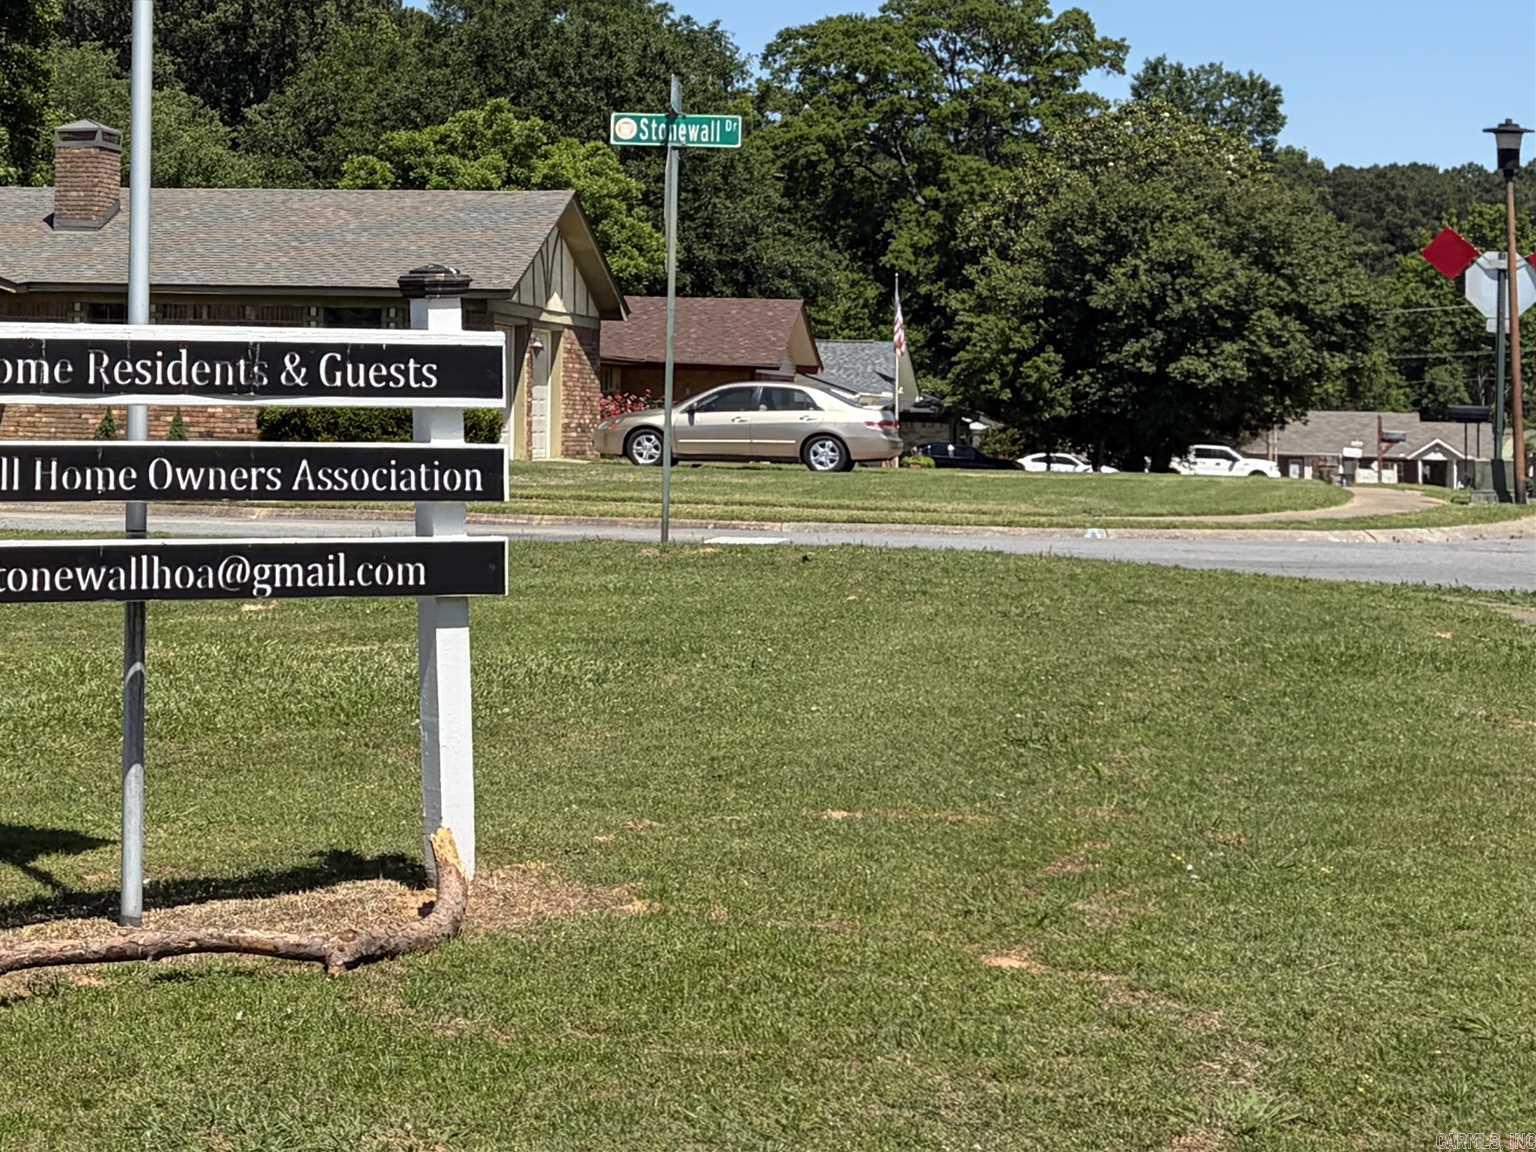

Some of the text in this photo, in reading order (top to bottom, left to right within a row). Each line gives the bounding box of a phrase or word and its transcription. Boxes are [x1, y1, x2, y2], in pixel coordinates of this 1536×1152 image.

[724, 118, 738, 133] Dr
[88, 348, 268, 386] Residents
[279, 352, 309, 387] &
[318, 352, 439, 388] Guests
[33, 458, 137, 491] Home
[147, 456, 282, 490] Owners
[291, 458, 484, 491] Association
